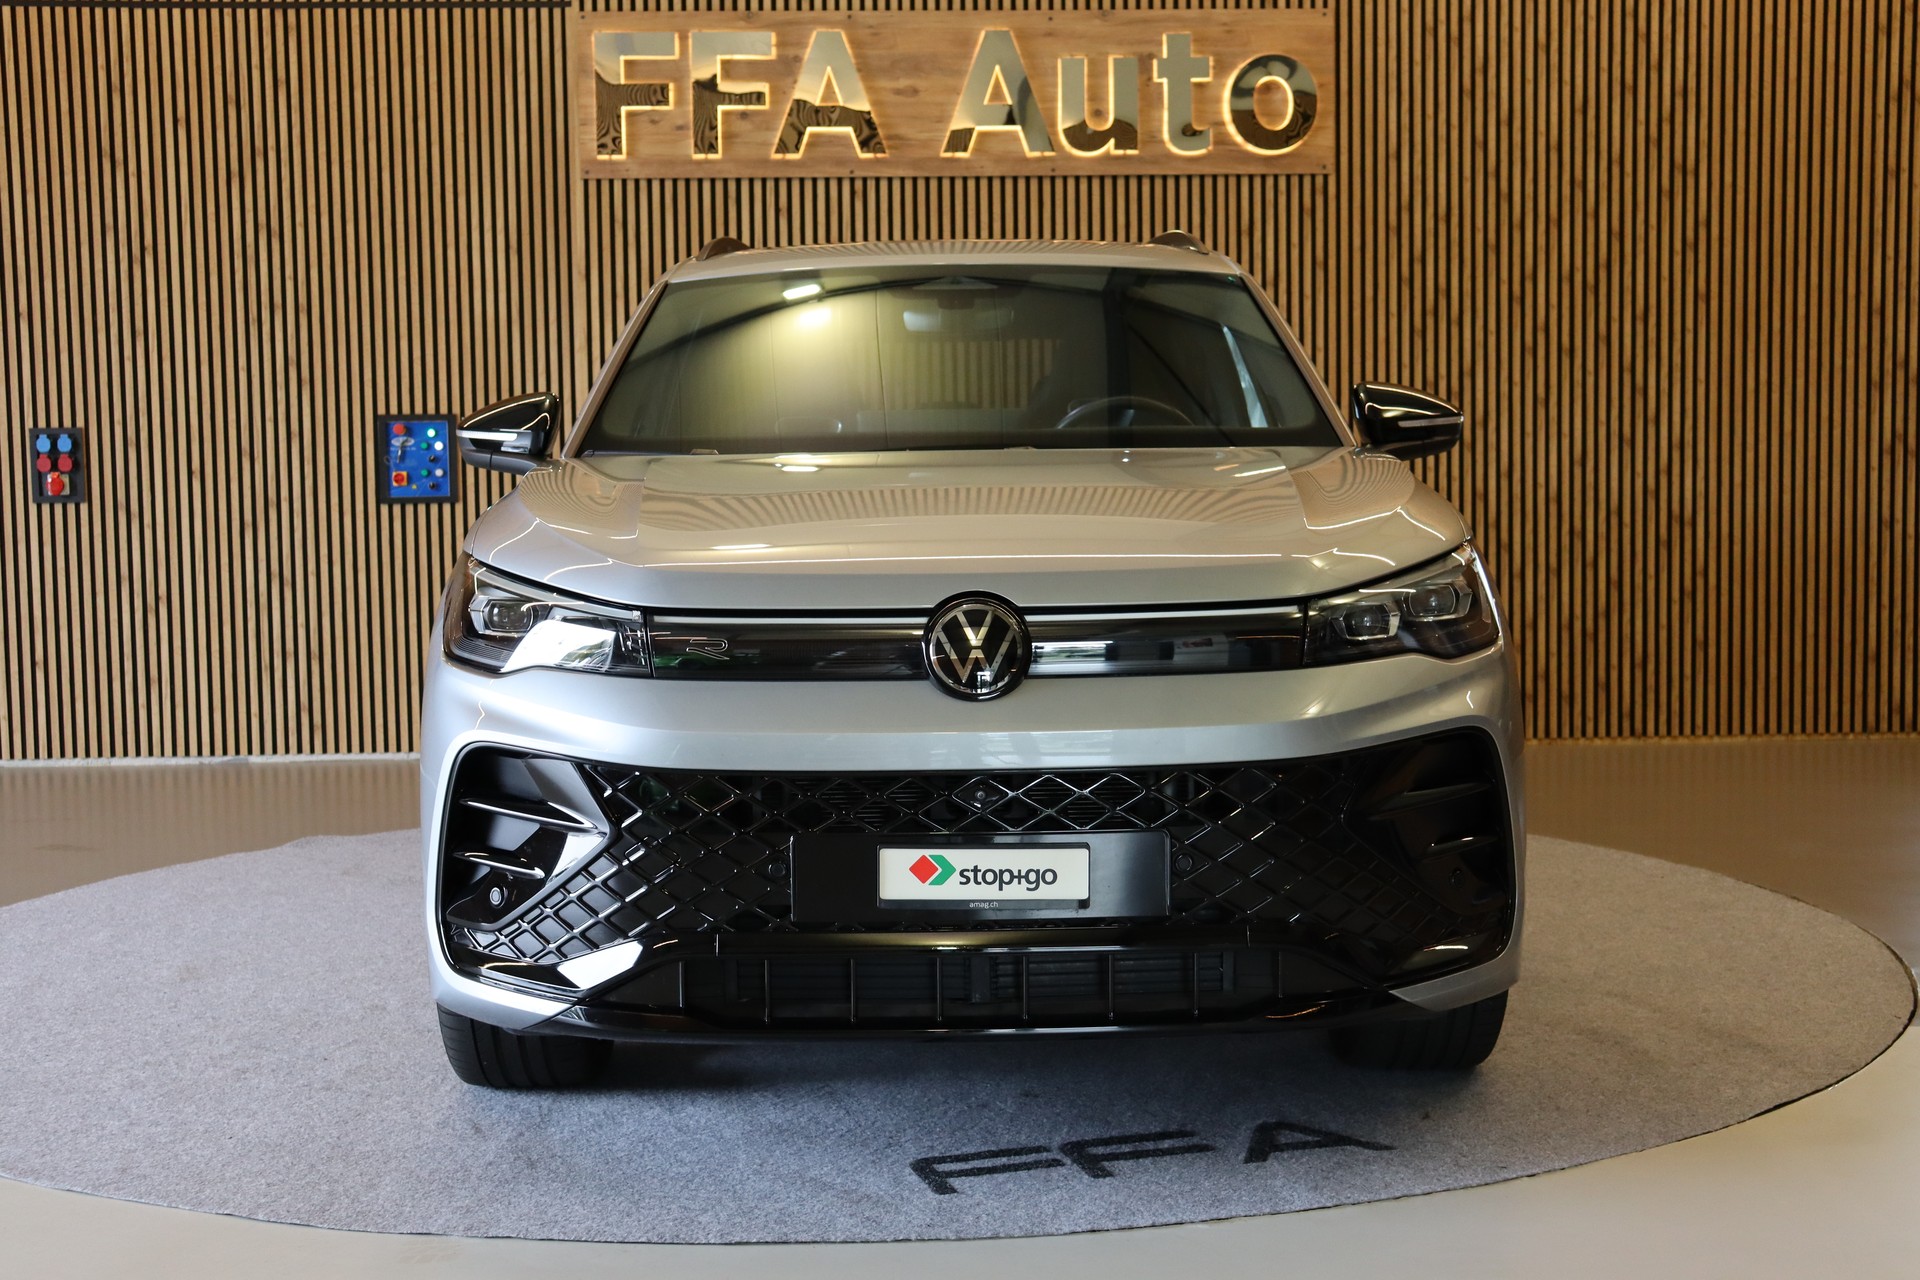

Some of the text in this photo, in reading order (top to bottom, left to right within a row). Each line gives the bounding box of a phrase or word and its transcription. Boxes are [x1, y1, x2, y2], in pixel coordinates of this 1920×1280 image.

[592, 28, 1319, 160] FFA Auto
[958, 864, 1058, 892] stop+go
[969, 901, 999, 909] amag.ch
[909, 1120, 1398, 1196] FFA
